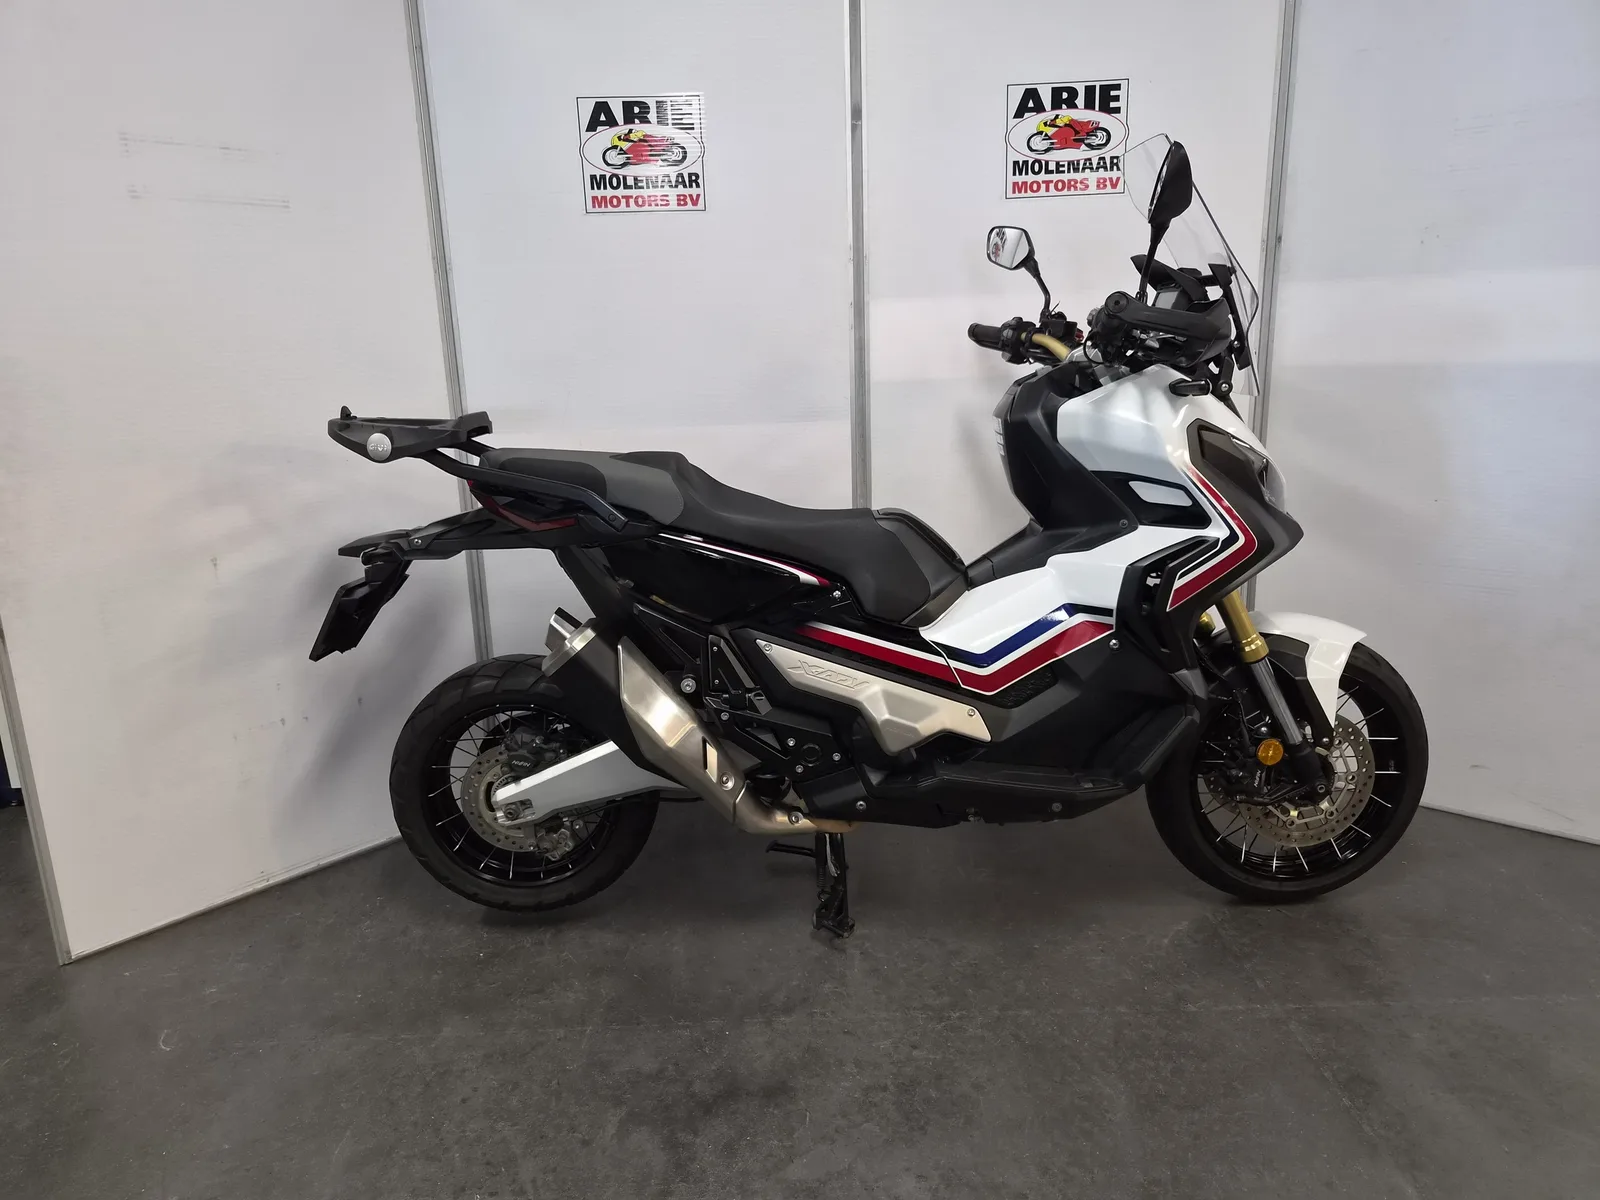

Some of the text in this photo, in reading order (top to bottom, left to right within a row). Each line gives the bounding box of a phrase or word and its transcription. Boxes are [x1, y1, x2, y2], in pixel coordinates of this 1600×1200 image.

[1012, 83, 1122, 119] ARIE
[585, 100, 695, 132] ARIE
[1012, 156, 1122, 176] MOLENAAR
[589, 172, 701, 190] MOLENAAR
[1012, 176, 1121, 194] MOTORS BV
[591, 193, 701, 208] MOTORS BV
